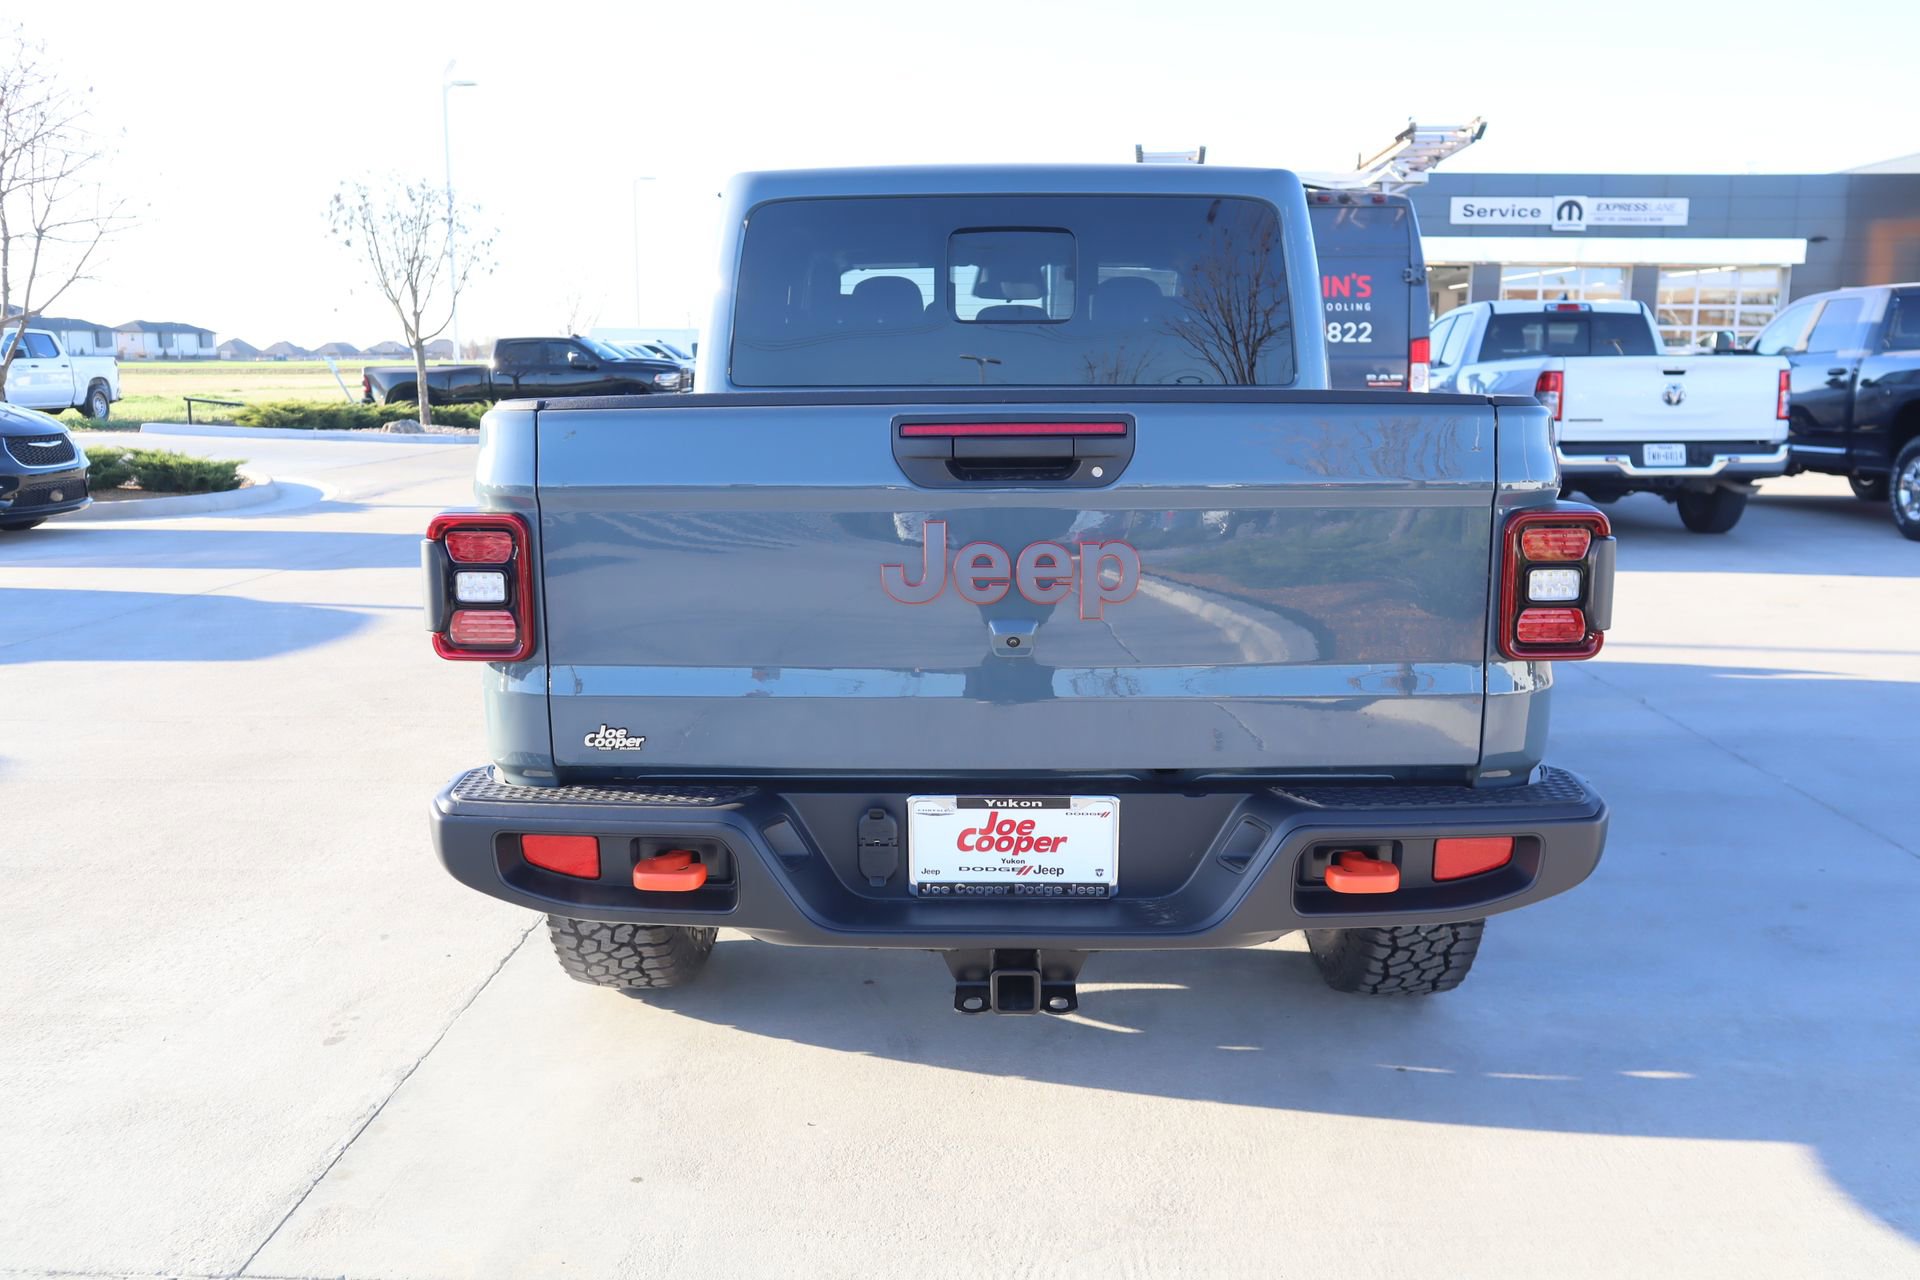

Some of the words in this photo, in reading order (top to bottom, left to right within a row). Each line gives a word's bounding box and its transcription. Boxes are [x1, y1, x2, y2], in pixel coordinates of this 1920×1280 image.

[1462, 203, 1542, 218] Service
[1596, 202, 1648, 212] EXPRESS
[1326, 302, 1371, 312] OOLING
[1327, 322, 1372, 343] 822
[880, 520, 1141, 620] Jeep
[595, 724, 628, 738] Joe
[584, 733, 645, 748] Cooper
[984, 799, 1043, 808] Yukon
[979, 811, 1036, 836] Joe
[957, 828, 1068, 856] Cooper
[921, 867, 941, 876] Jeep
[1033, 864, 1065, 877] Jeep
[921, 883, 950, 894] Joe
[955, 883, 1010, 897] Cooper
[1014, 883, 1063, 897] Dodge
[1067, 884, 1106, 897] Jeep
